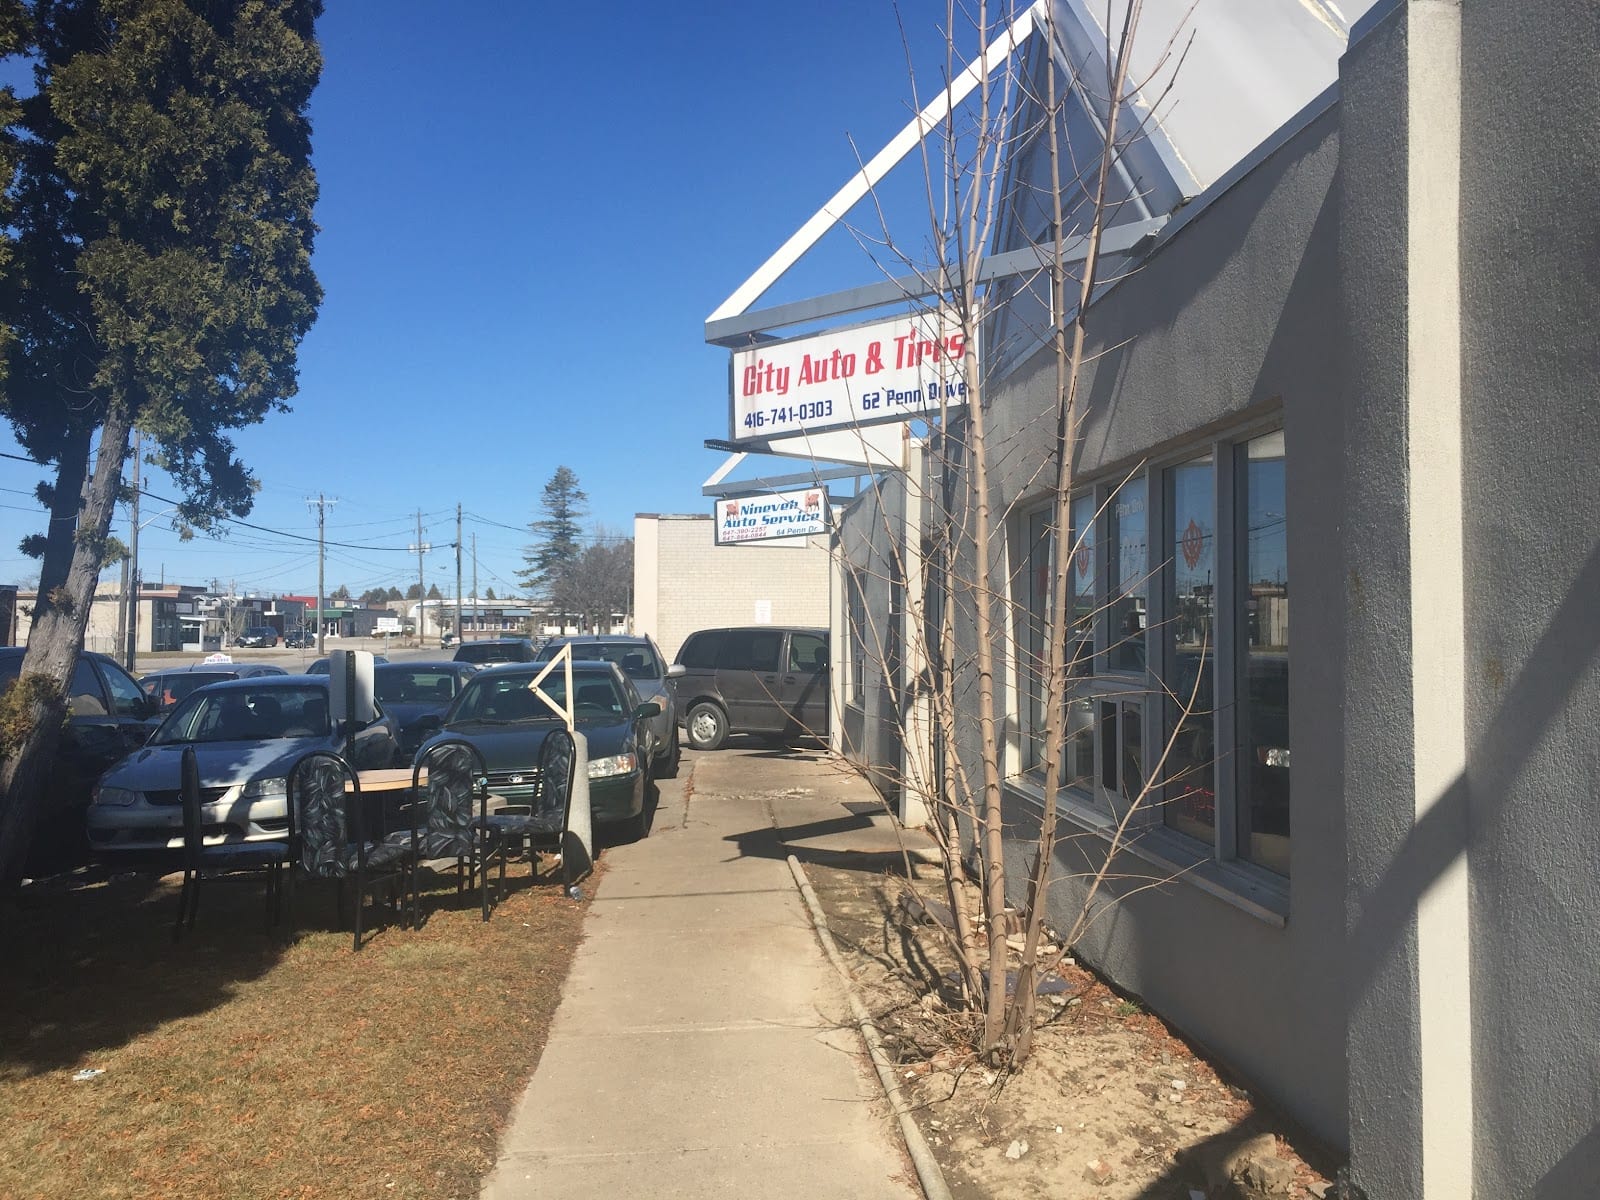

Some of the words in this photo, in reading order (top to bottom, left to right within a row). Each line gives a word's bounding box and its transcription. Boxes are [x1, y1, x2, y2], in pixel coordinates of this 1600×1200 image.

[743, 359, 790, 396] City
[798, 348, 856, 387] Auto
[865, 341, 885, 375] &
[893, 328, 966, 370] Tires
[863, 392, 880, 410] 62
[887, 389, 921, 406] Penn
[745, 400, 833, 428] 416-741-0303
[740, 500, 798, 516] Nineveh
[723, 517, 757, 529] Auto
[761, 511, 820, 526] Service
